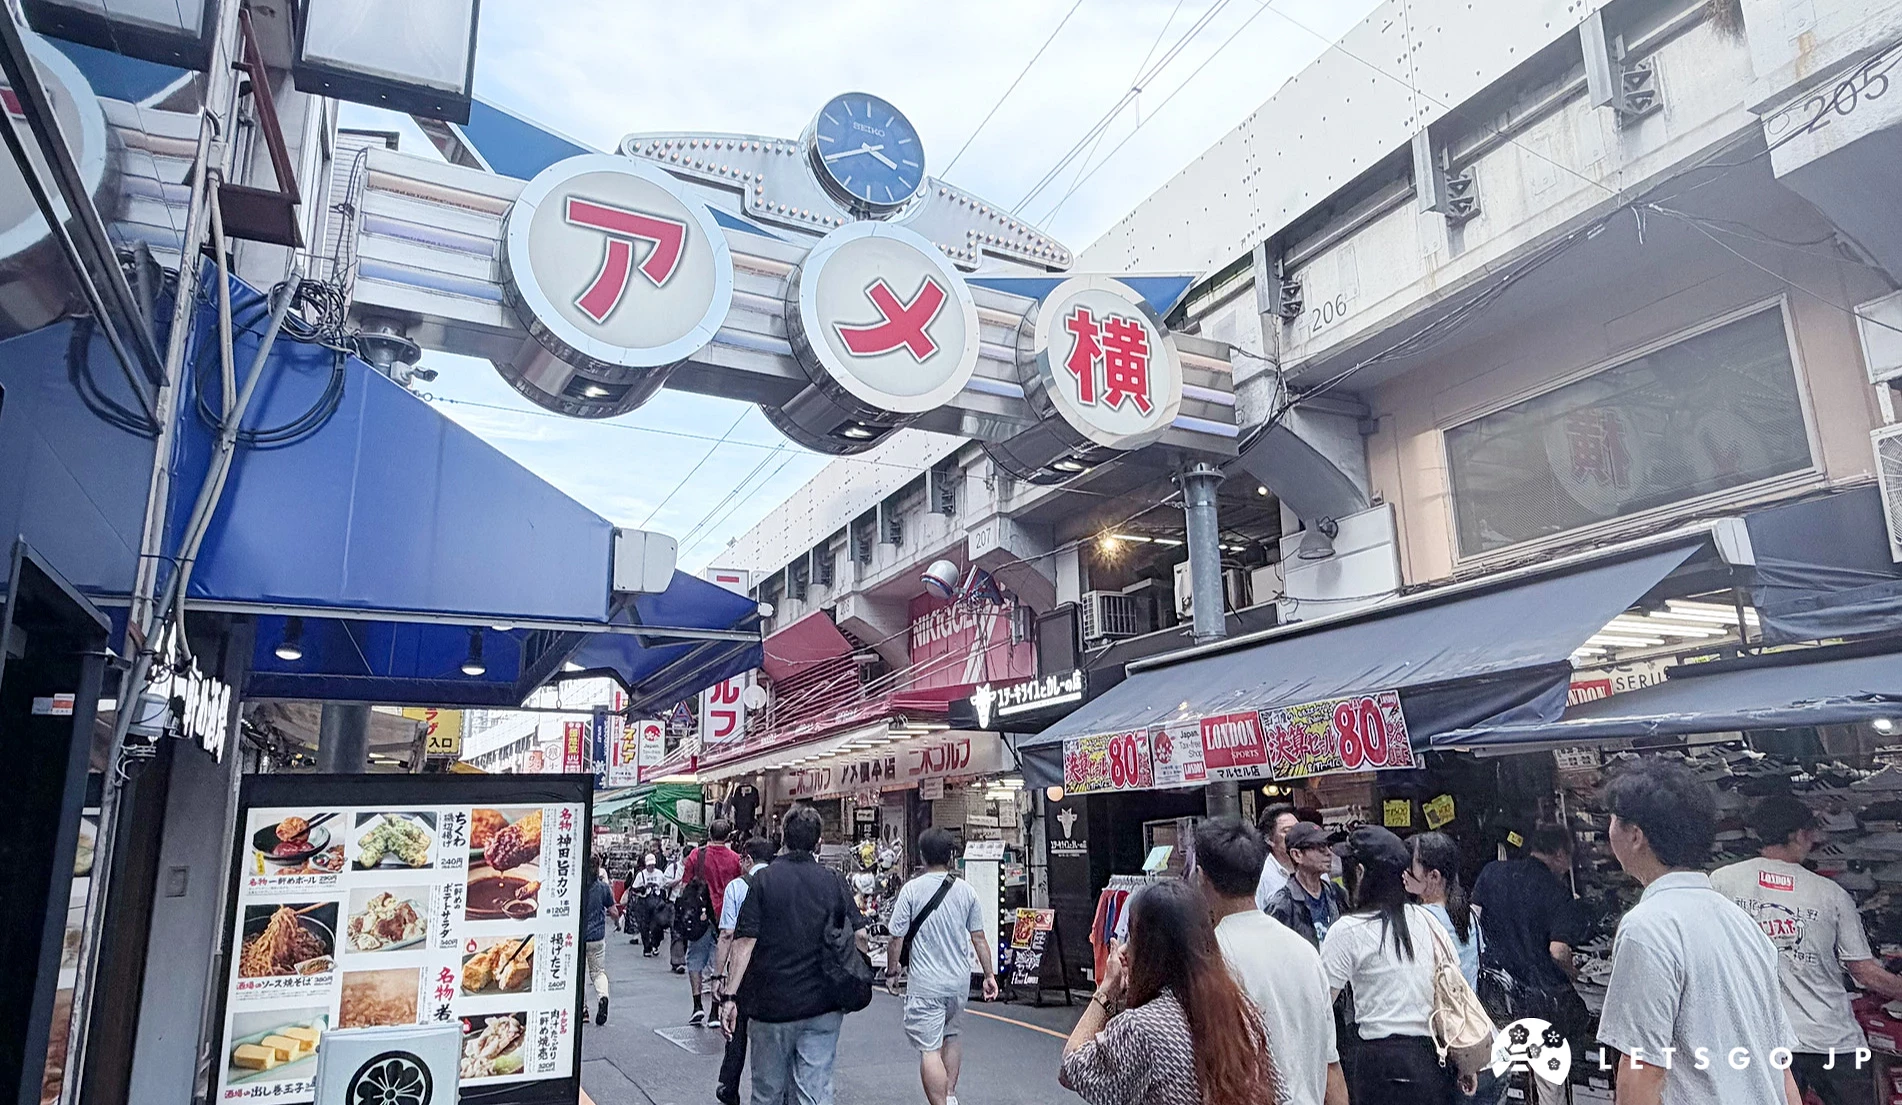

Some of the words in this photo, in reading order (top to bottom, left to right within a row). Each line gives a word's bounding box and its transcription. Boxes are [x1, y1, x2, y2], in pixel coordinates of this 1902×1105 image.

[1804, 60, 1889, 134] 205
[853, 121, 886, 137] SEIKO
[1312, 293, 1347, 332] 206
[976, 527, 991, 549] 207
[429, 737, 453, 748] 入口
[1179, 729, 1199, 740] Japan
[1204, 719, 1258, 750] LONDON
[1267, 724, 1336, 765] 決算セール
[1232, 749, 1259, 759] SPORTS
[1216, 765, 1261, 778] マルセル店
[453, 811, 467, 846] ちくわ
[440, 857, 464, 866] 240円
[440, 882, 453, 939] ポテトサラダ
[550, 932, 564, 979] 揚げたて
